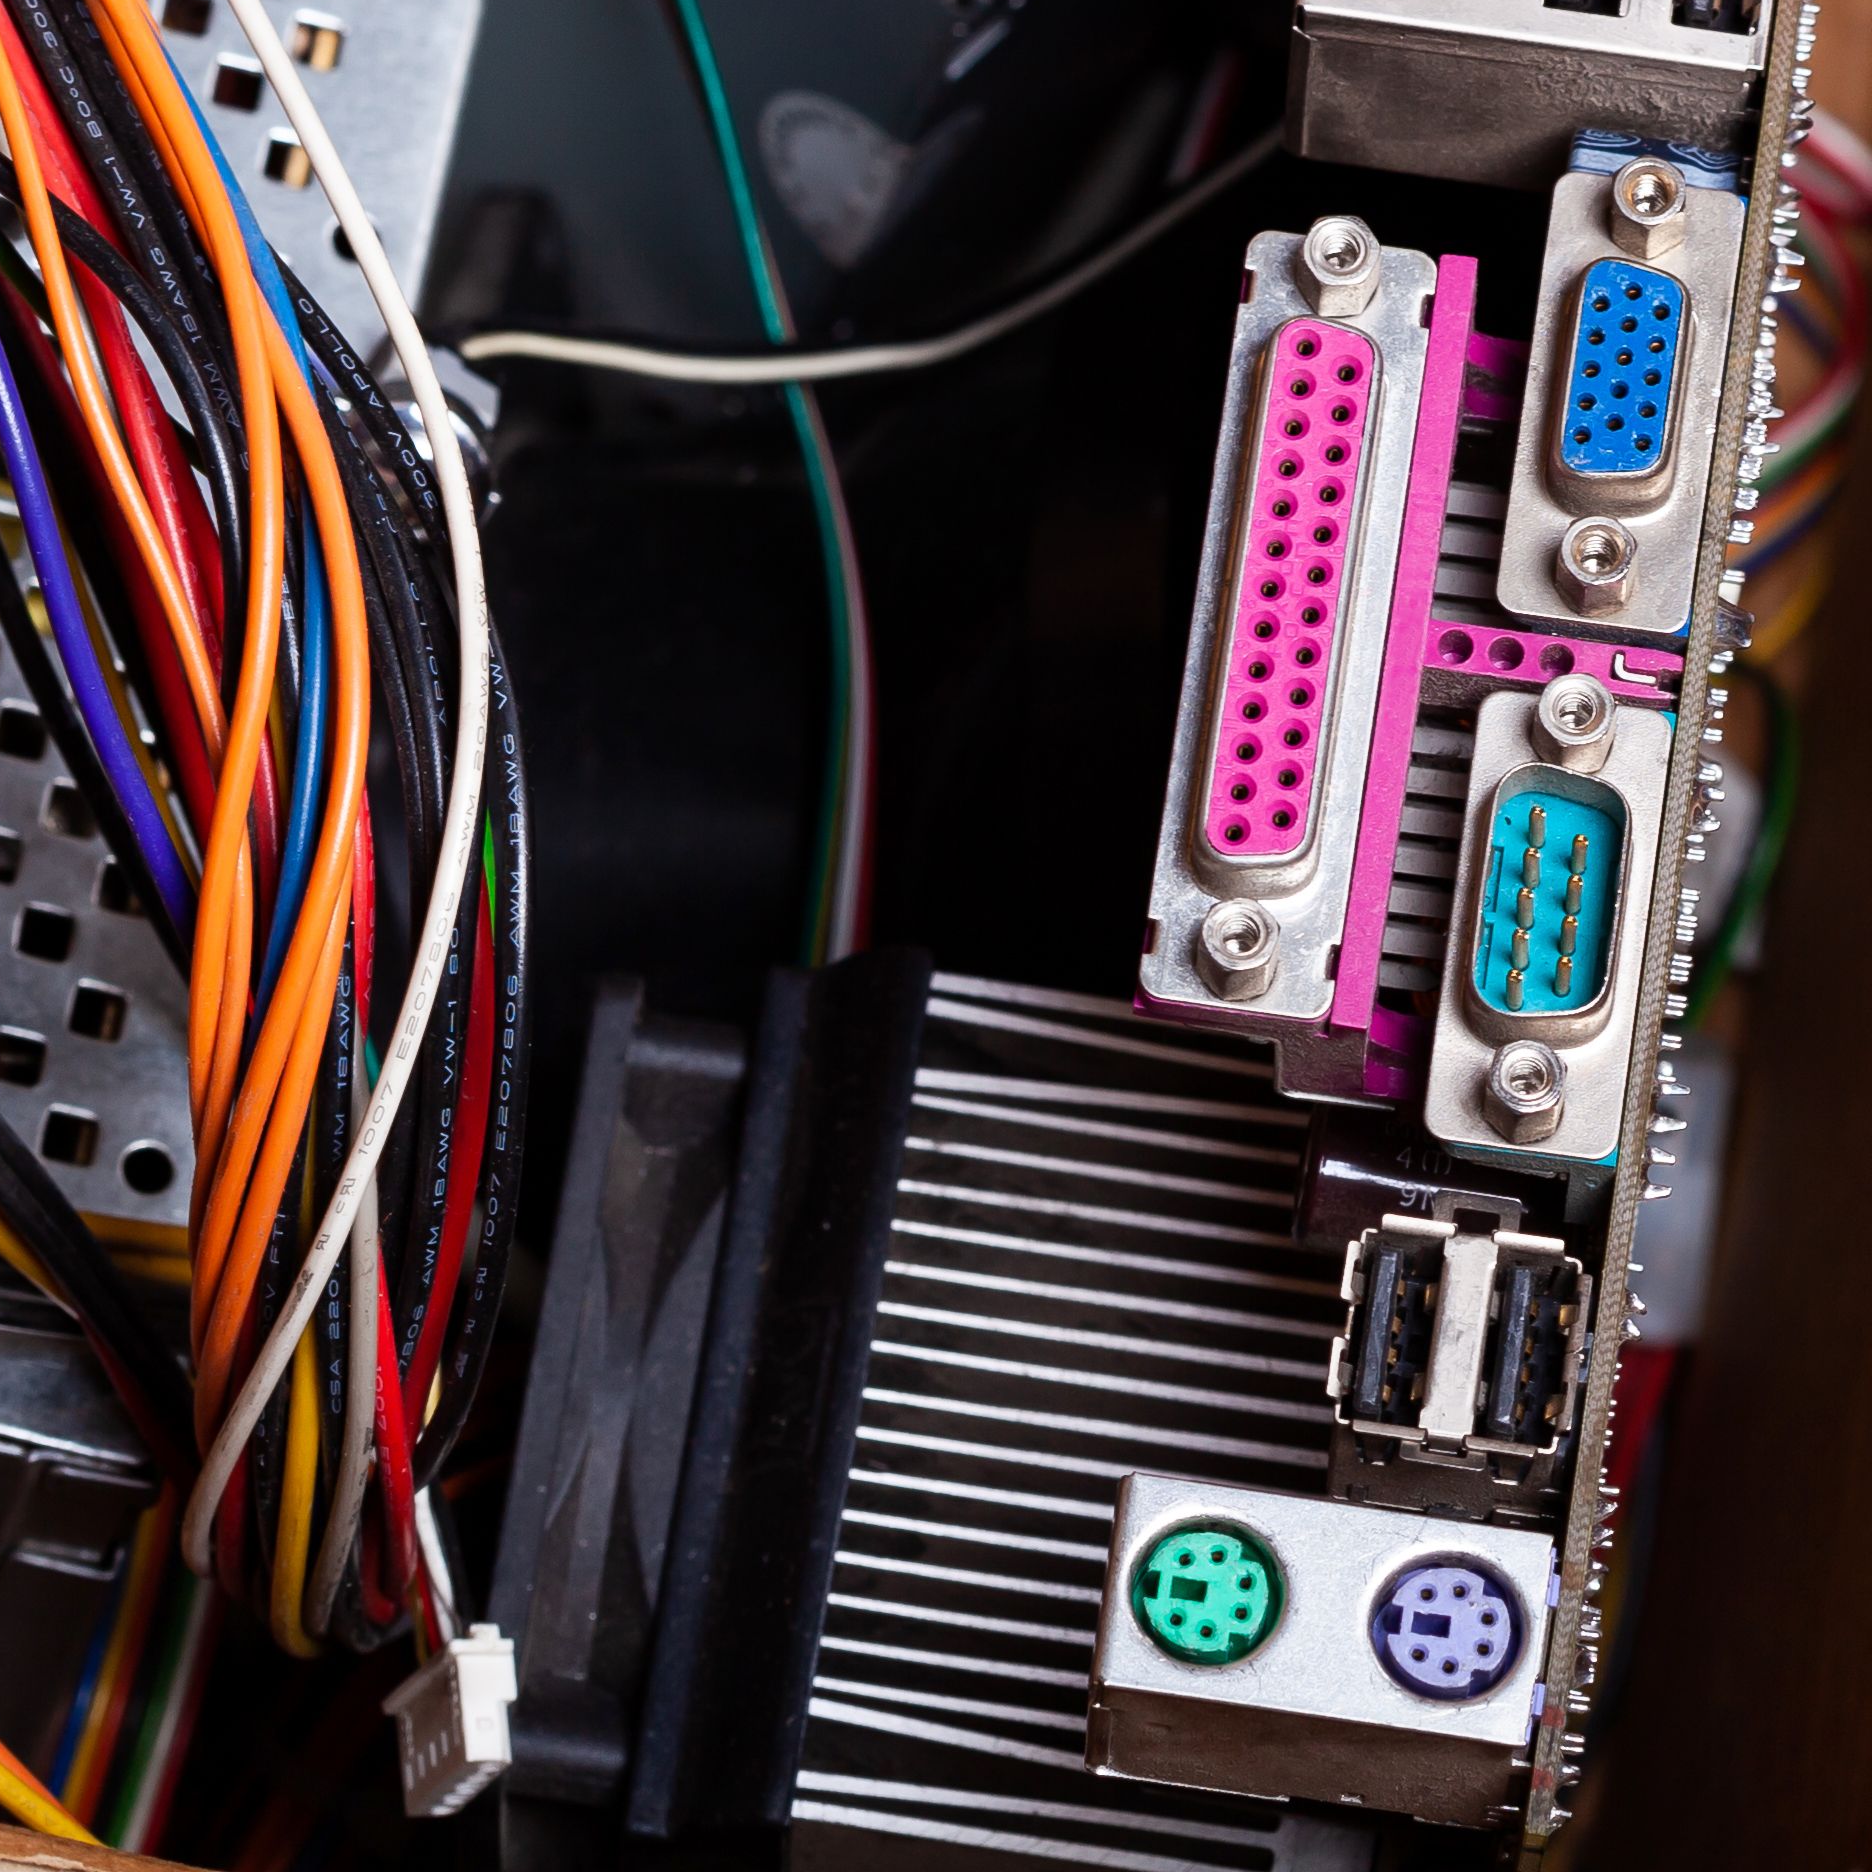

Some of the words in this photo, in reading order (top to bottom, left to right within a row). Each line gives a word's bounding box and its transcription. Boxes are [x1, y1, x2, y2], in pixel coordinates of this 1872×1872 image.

[102, 154, 146, 229] VW-1
[149, 246, 202, 344] 18AWG
[202, 362, 243, 427] AWM
[297, 297, 385, 409] APOLLO
[387, 430, 439, 510] 300V
[502, 732, 521, 846] 18AWG
[508, 871, 524, 949] AWM
[358, 1079, 395, 1156] 1007
[395, 891, 456, 1061] E207806
[456, 794, 476, 867] AWM
[336, 975, 351, 1090] 18AWG
[442, 999, 458, 1085] VW-1
[495, 974, 519, 1151] E207806
[433, 1106, 453, 1209] 18AWG
[484, 1172, 502, 1247] 1007
[422, 1224, 441, 1288] AWM
[398, 1303, 425, 1383] 7806
[329, 1359, 343, 1415] CSA
